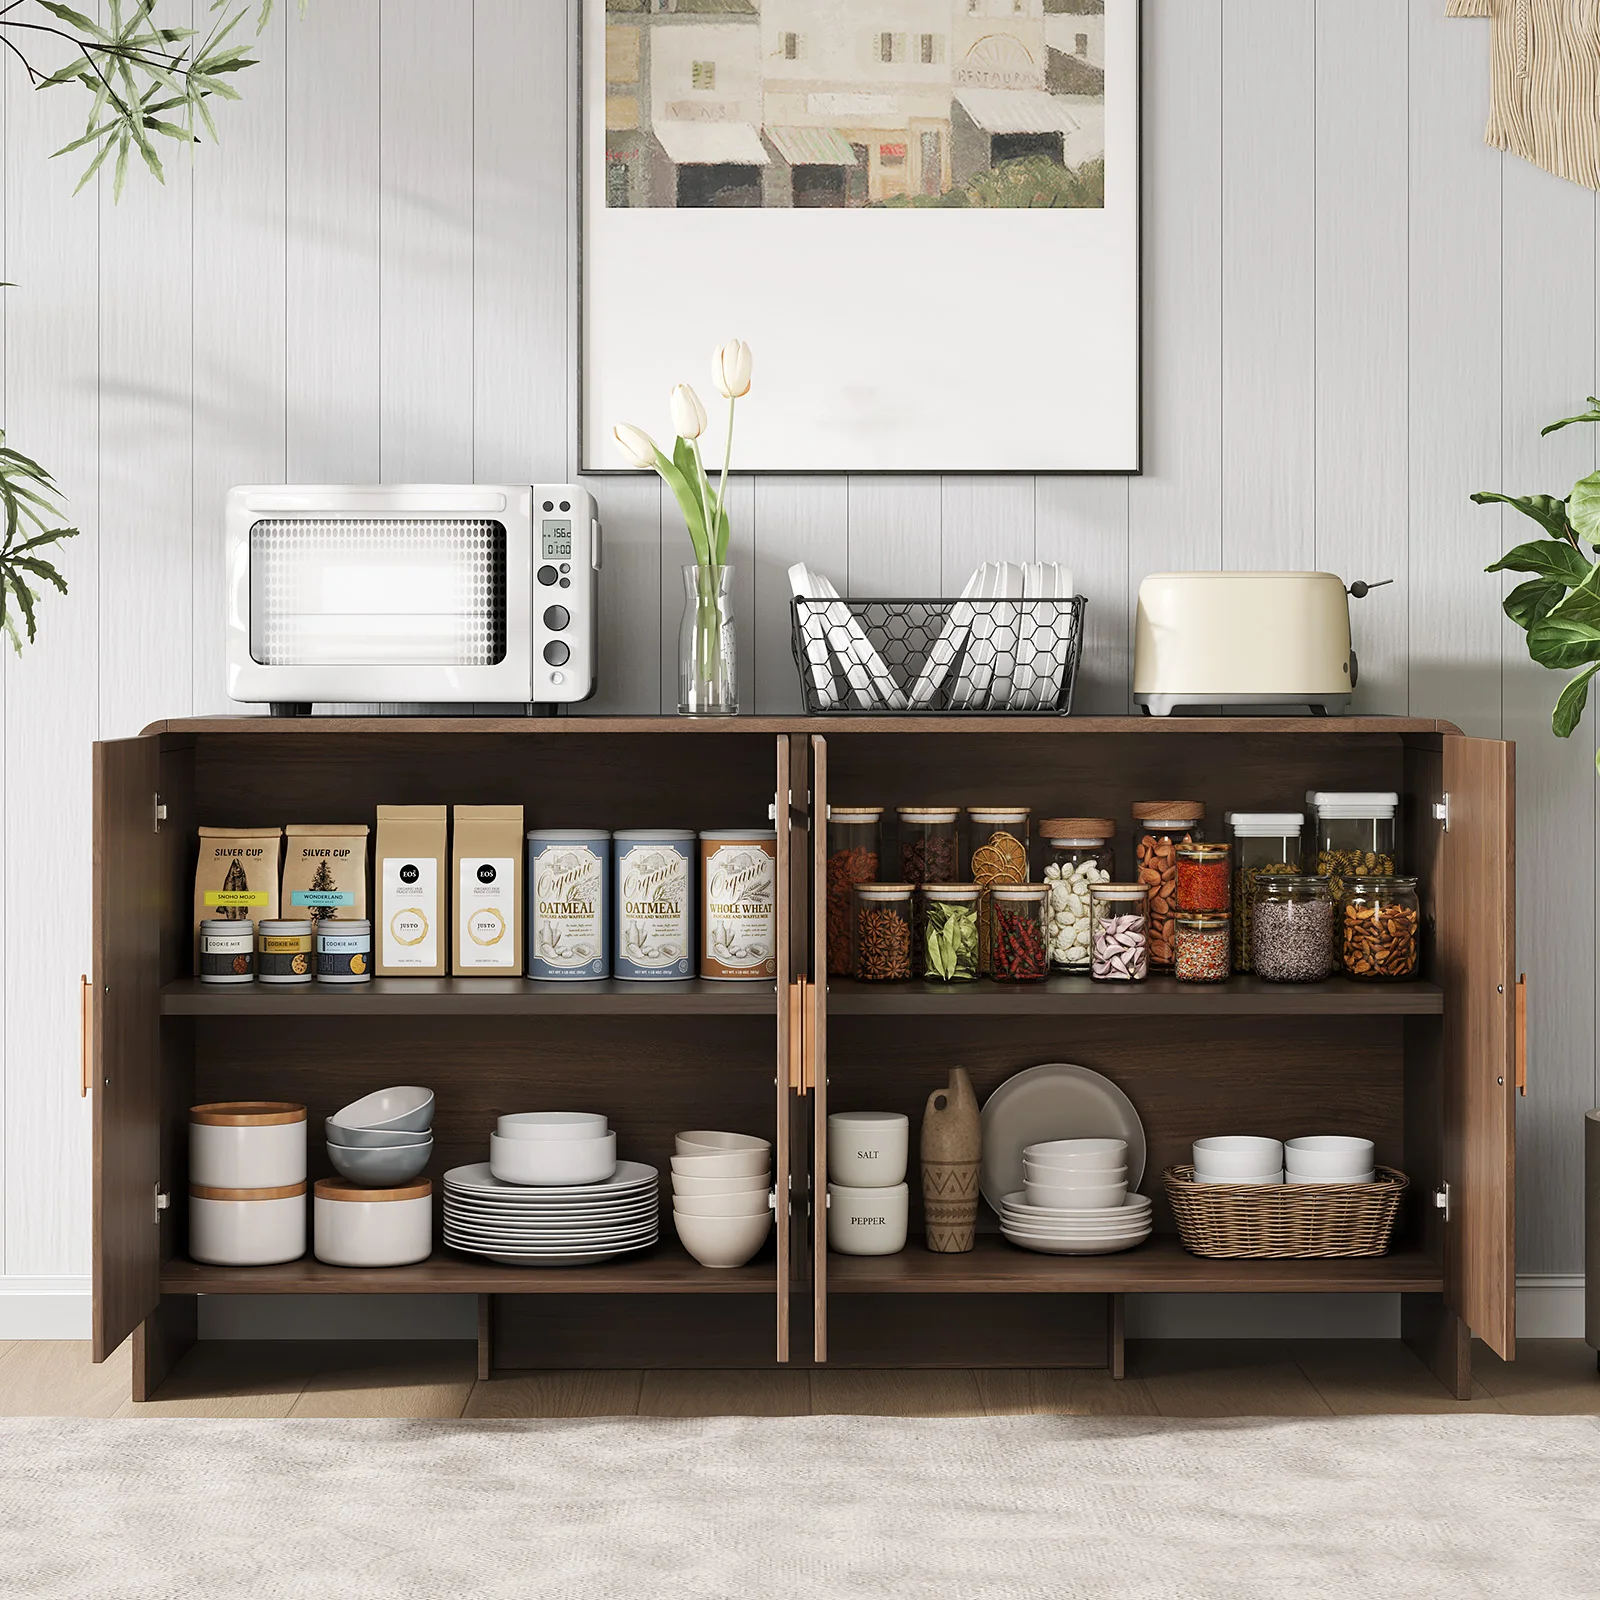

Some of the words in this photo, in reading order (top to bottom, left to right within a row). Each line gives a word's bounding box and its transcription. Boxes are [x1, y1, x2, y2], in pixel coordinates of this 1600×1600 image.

[548, 544, 571, 554] 01:00
[214, 848, 243, 856] SILVER
[246, 848, 264, 856] CUP
[302, 848, 330, 857] SILVER
[333, 849, 350, 857] CUP
[538, 860, 592, 900] Organic
[624, 860, 679, 900] Organic
[711, 860, 766, 900] Organic
[539, 901, 595, 914] OATMEAL
[625, 901, 681, 914] OATMEAL
[710, 904, 740, 914] WHOLE
[742, 904, 772, 914] WHEAT
[857, 1150, 879, 1159] SALT
[851, 1217, 886, 1225] PEPPER
